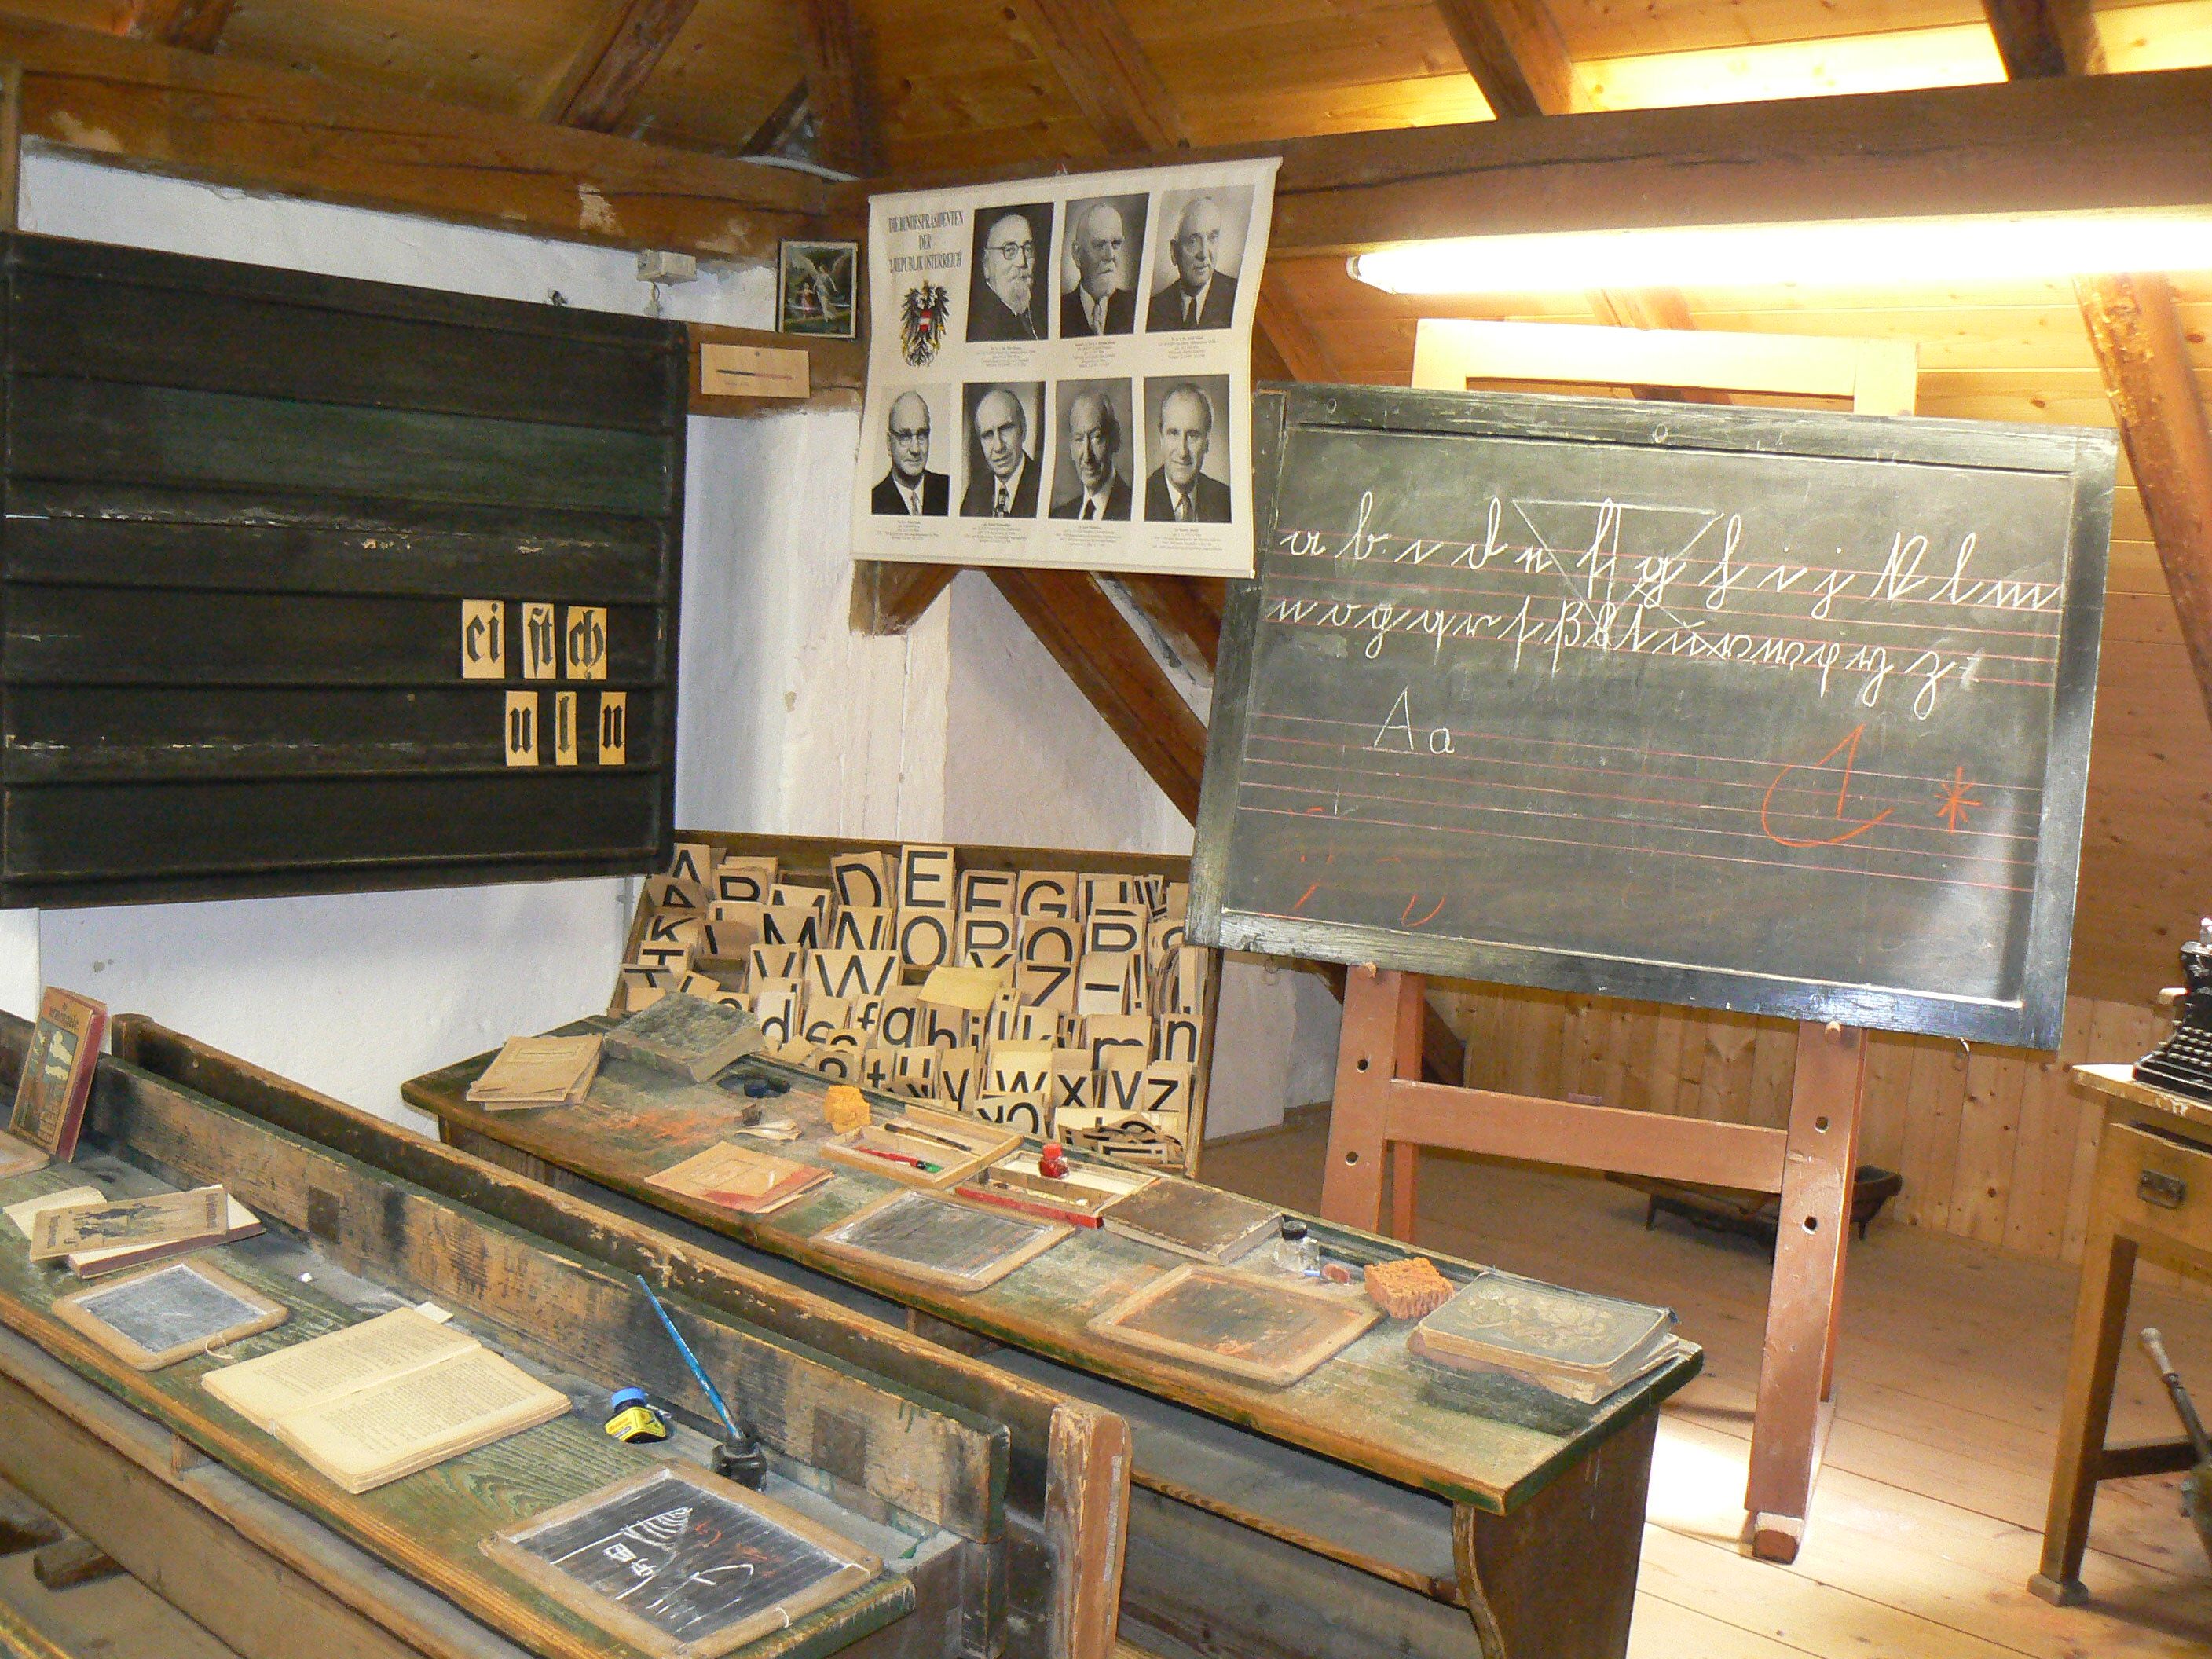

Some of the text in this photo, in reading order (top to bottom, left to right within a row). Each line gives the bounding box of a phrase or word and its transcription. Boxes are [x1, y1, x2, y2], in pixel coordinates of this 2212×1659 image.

[917, 233, 932, 250] DER
[1372, 684, 1456, 755] A a
[835, 863, 882, 907] D
[905, 851, 948, 908] E
[1021, 879, 1067, 919] G
[763, 912, 818, 949] M
[900, 914, 948, 966] O
[815, 954, 896, 998] W
[761, 998, 792, 1044] d
[857, 1001, 879, 1031] f
[928, 1009, 958, 1049] h
[1164, 1020, 1197, 1063] n
[1057, 1073, 1088, 1108] x
